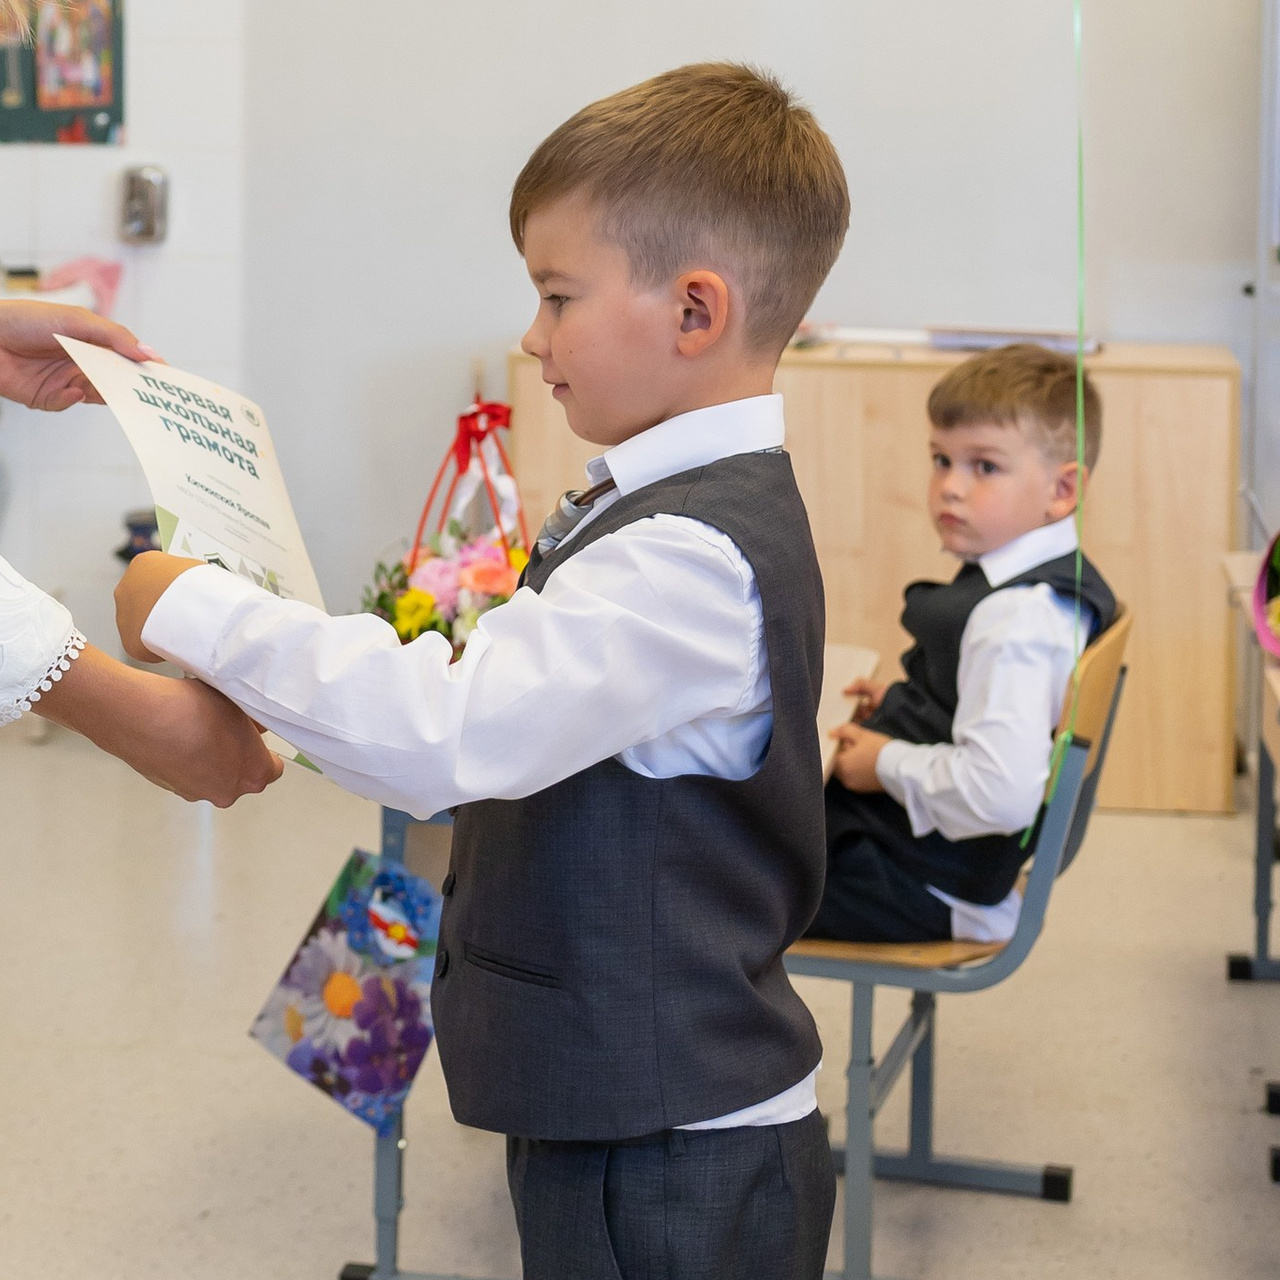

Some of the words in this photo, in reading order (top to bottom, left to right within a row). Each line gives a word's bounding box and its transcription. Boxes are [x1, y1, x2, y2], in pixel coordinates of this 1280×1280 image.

[132, 387, 259, 458] школьная
[138, 373, 233, 423] первая
[158, 414, 260, 480] грамота
